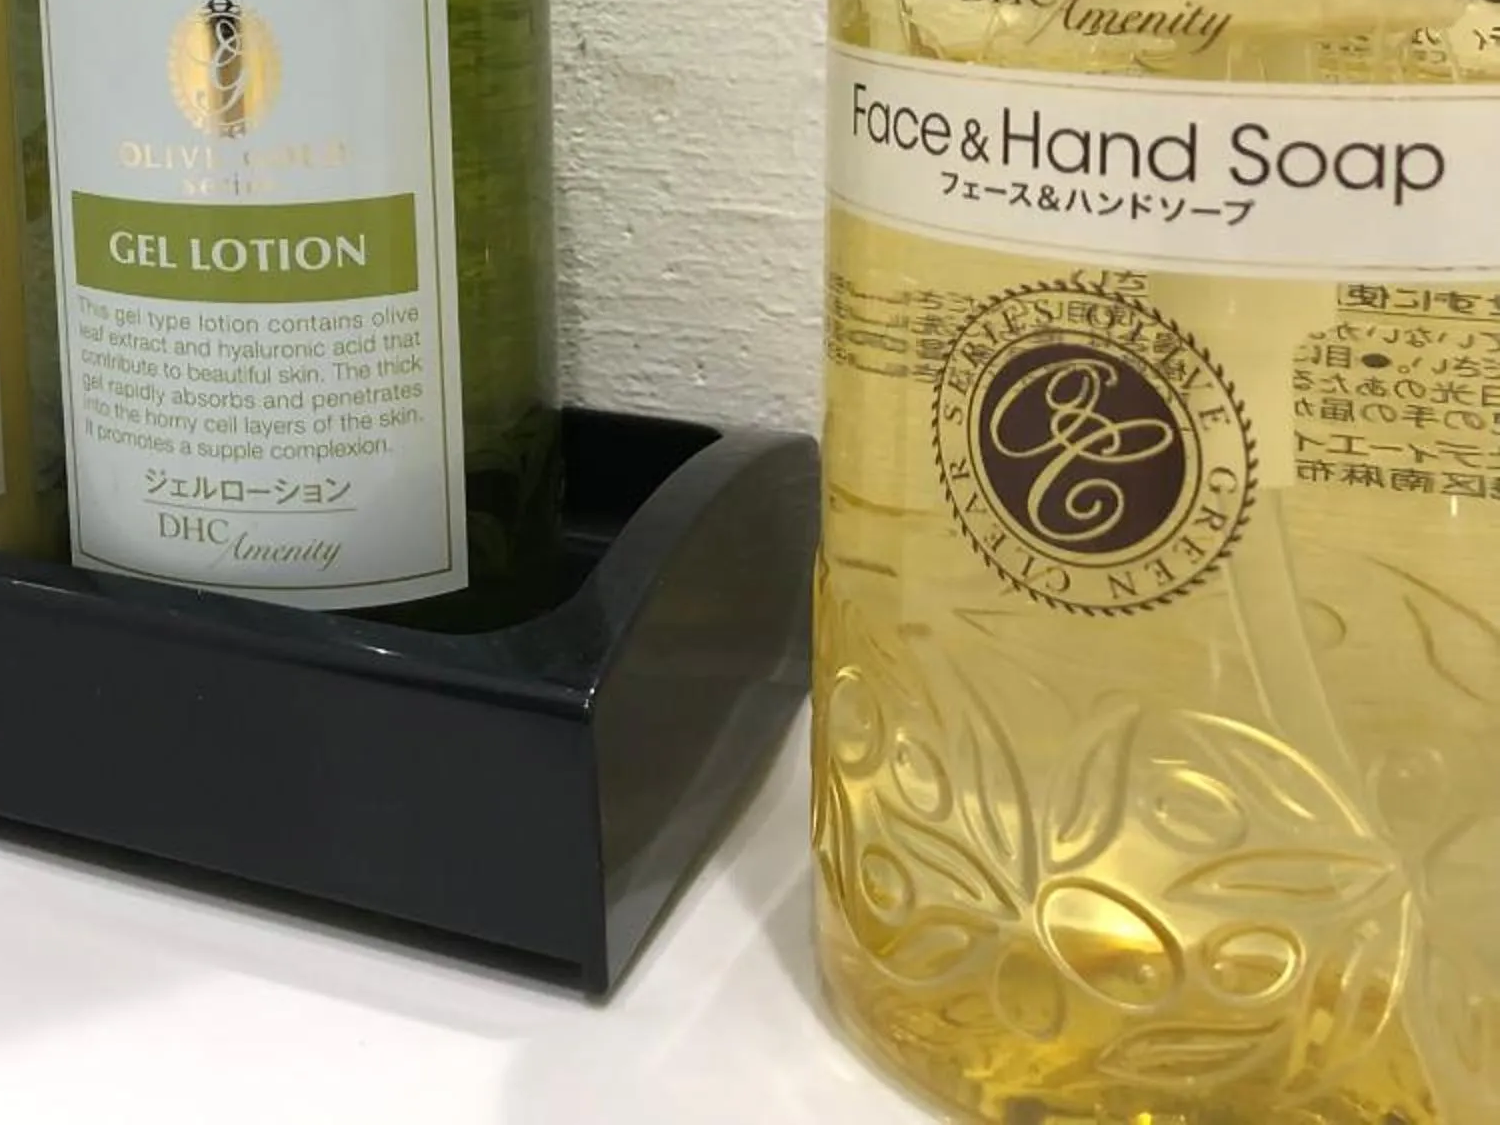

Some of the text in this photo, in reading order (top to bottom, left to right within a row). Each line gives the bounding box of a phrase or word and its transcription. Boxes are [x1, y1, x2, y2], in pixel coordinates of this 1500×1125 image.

[1228, 121, 1446, 206] Soap
[940, 171, 1257, 227] フェース&ハンドソープ
[108, 231, 368, 272] GEL LOTION
[77, 294, 420, 334] This gel type lotion contains olive
[80, 346, 424, 386] contribute to beautiful skin. The thick
[108, 330, 168, 354] extract
[173, 338, 212, 358] and
[217, 338, 326, 363] hyaluronic
[332, 333, 377, 357] acid
[382, 330, 422, 352] that
[82, 372, 424, 413] gel rapidly absorbs and penetrates
[113, 402, 141, 424] the
[203, 414, 239, 435] cell
[243, 416, 307, 439] layers
[312, 413, 333, 435] of
[339, 411, 374, 433] the
[378, 405, 424, 428] skin.
[96, 424, 175, 454] promotes
[179, 439, 192, 456] a
[196, 440, 265, 463] supple
[270, 433, 395, 464] complexion.
[143, 467, 352, 506] ジェルローション
[158, 512, 343, 572] DHC Amenity
